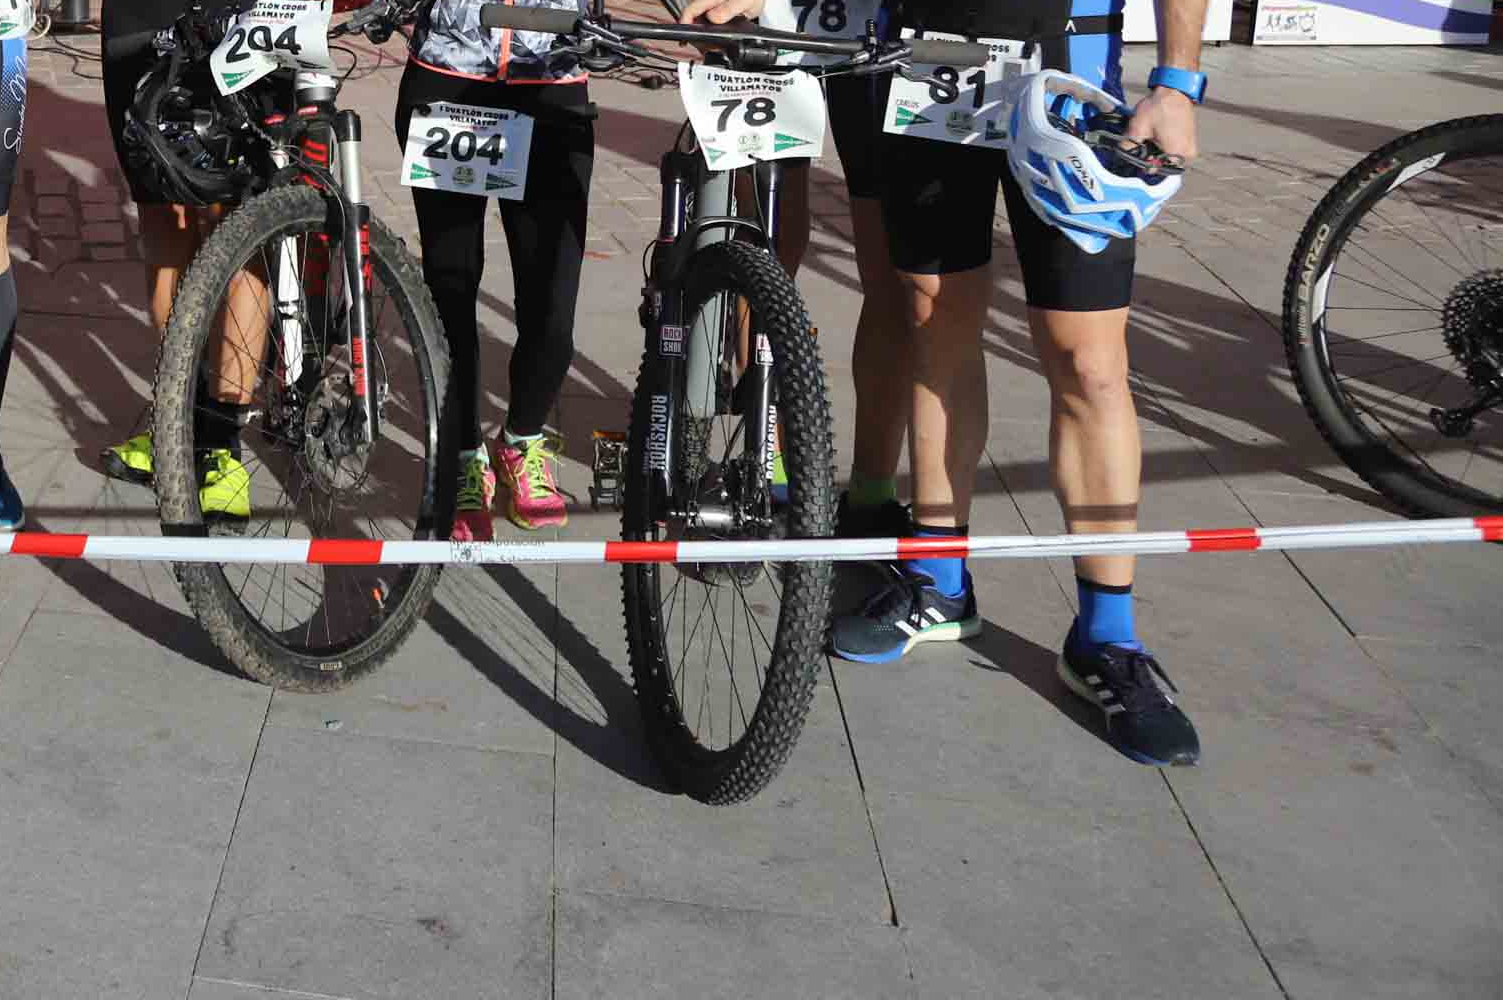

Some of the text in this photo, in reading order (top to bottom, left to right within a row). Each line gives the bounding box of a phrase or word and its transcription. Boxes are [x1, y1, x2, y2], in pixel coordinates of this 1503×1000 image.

[225, 24, 302, 64] 204
[720, 83, 782, 93] VILLAMAYOR
[763, 76, 795, 88] CROSS
[928, 65, 986, 109] 81
[710, 96, 777, 133] 78
[423, 126, 504, 166] 204
[1297, 223, 1330, 301] BARZO
